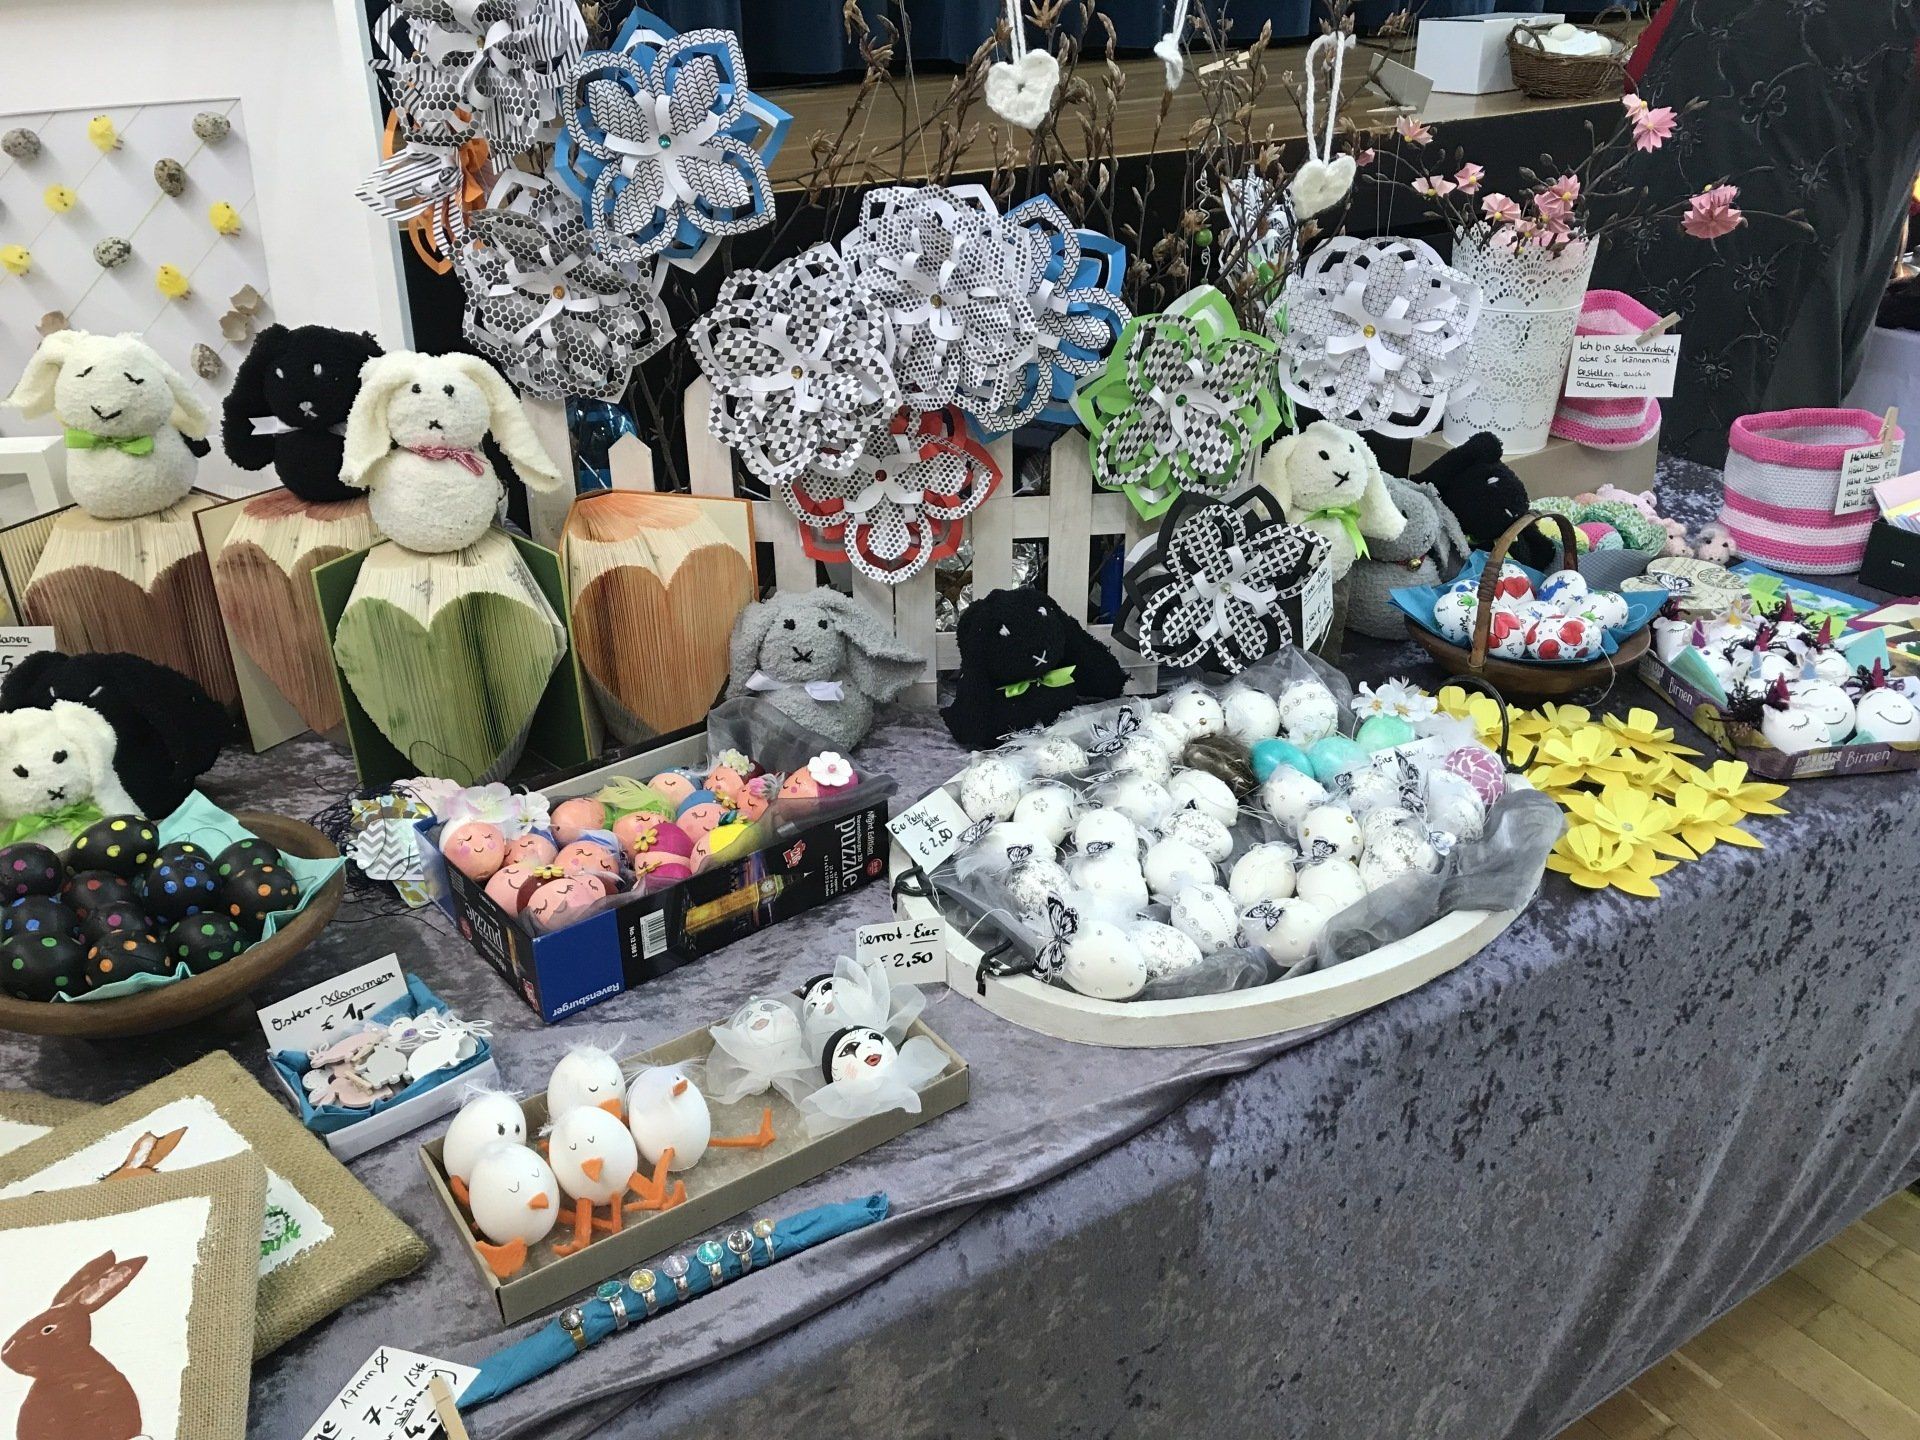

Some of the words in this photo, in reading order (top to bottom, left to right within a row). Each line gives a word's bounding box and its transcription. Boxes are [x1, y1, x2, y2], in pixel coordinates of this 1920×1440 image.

[1580, 341, 1593, 351] Ich
[1595, 341, 1611, 352] bin
[1578, 354, 1599, 363] aber
[1604, 354, 1617, 364] Sie
[0, 634, 32, 644] asen
[1668, 676, 1693, 705] Birnen
[1845, 750, 1890, 768] Birnen
[865, 810, 877, 831] Night
[891, 823, 907, 834] Eier
[867, 831, 875, 856] Edition
[919, 841, 930, 856] €
[929, 828, 953, 848] 2,50
[834, 816, 863, 889] puzzle
[893, 951, 934, 968] 2,50
[552, 982, 620, 1017] Ravensburger
[320, 1014, 335, 1032] €
